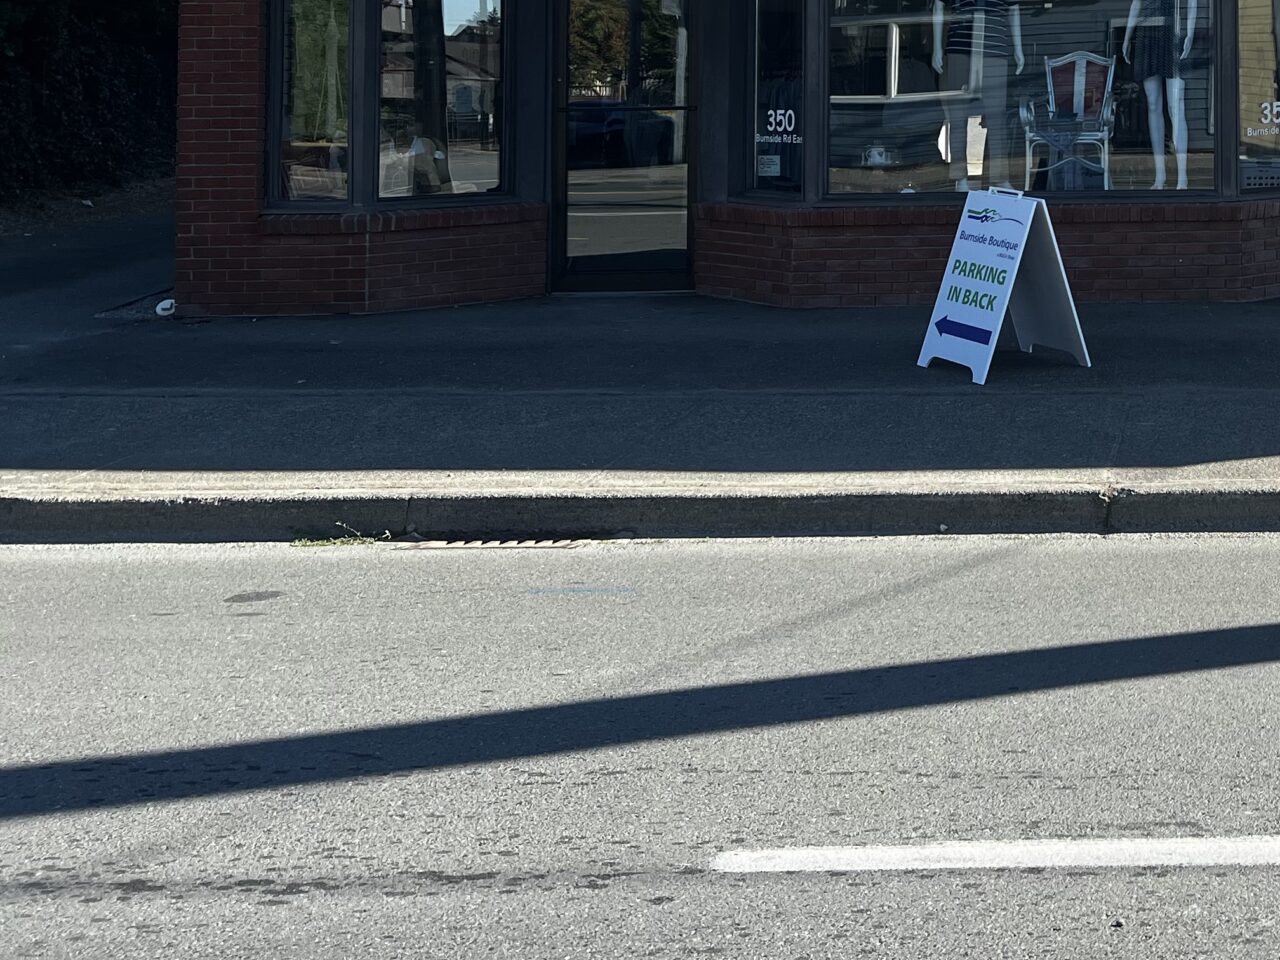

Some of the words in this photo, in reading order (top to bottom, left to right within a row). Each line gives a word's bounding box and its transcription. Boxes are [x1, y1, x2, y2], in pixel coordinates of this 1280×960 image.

[767, 109, 795, 131] 350
[756, 133, 782, 143] Burnside
[783, 134, 792, 143] Rd
[1247, 126, 1280, 136] Burnside
[959, 230, 988, 246] Burnside
[988, 236, 1019, 251] Boutique
[951, 259, 1008, 286] PARKING
[946, 285, 963, 303] IN
[961, 290, 998, 312] BACK
